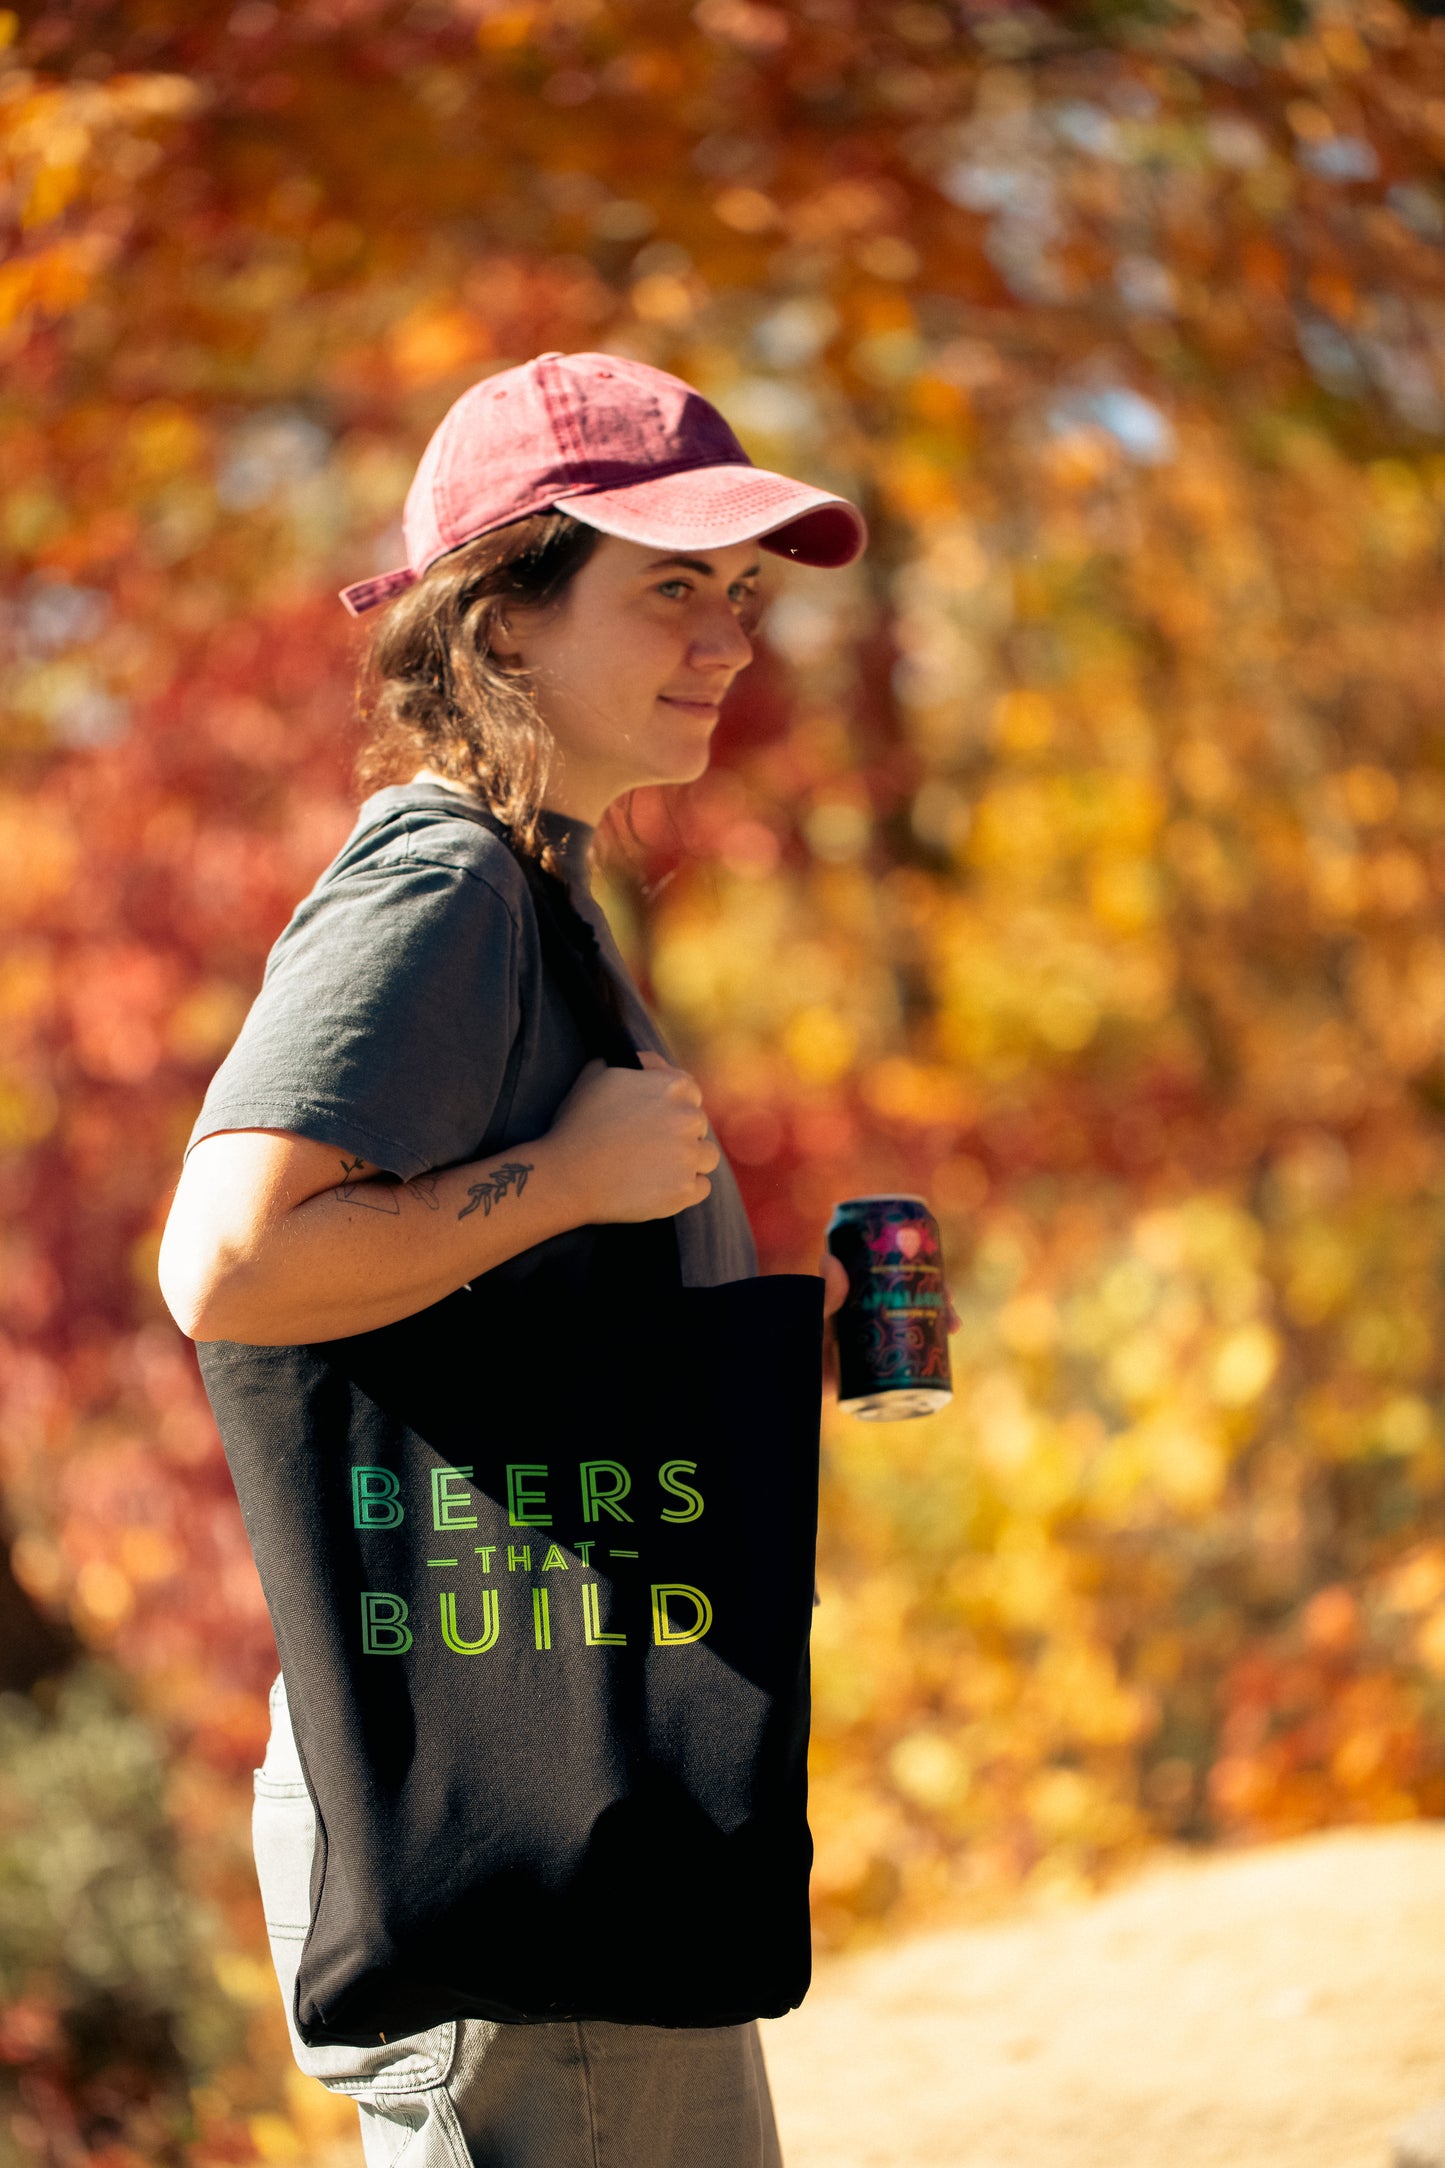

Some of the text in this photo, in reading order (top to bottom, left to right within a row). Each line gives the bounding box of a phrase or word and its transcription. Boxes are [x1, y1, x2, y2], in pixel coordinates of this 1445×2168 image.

[351, 1460, 704, 1531] BEERS
[474, 1540, 596, 1574] THAT
[360, 1583, 713, 1656] BUILD
